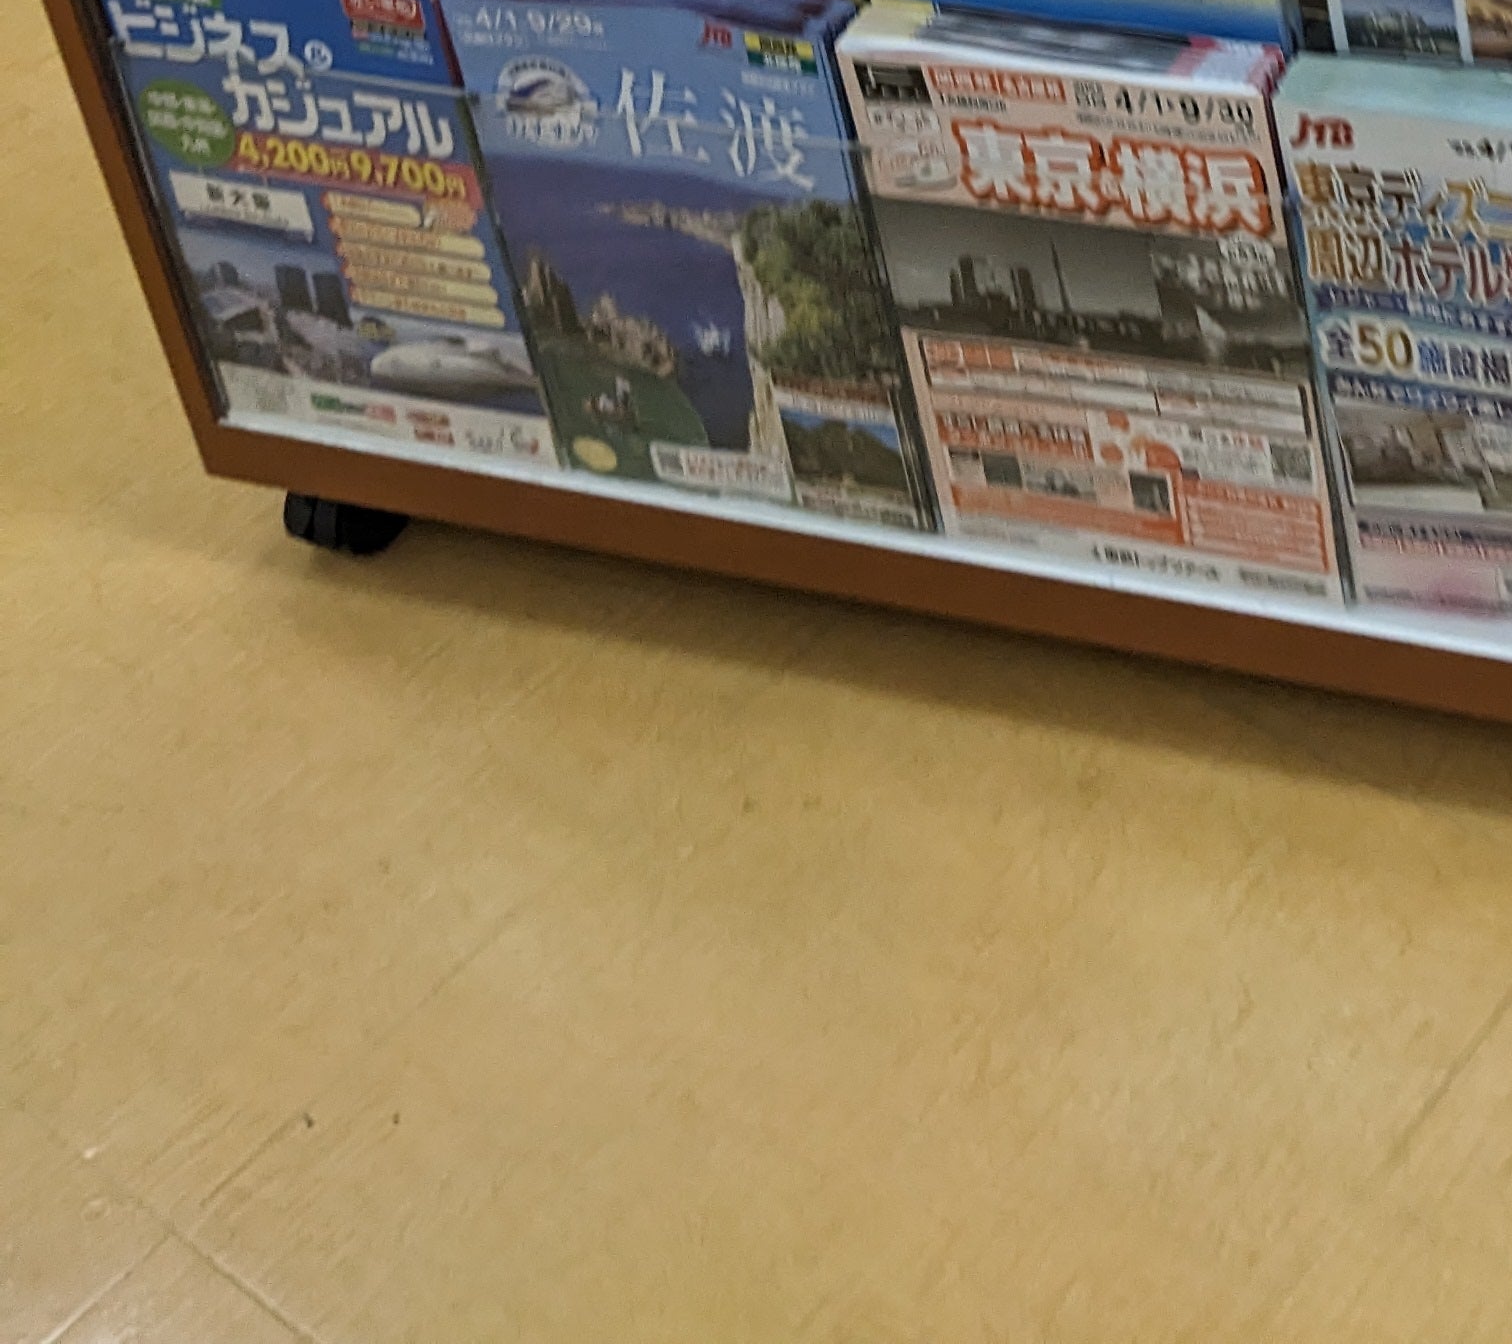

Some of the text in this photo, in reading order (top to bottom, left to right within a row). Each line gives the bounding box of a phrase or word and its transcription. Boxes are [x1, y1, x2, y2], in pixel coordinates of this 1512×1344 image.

[222, 76, 454, 158] カジュアル
[618, 67, 815, 191] 佐渡
[1292, 112, 1355, 150] JTB
[951, 118, 1274, 237] 東京・横浜
